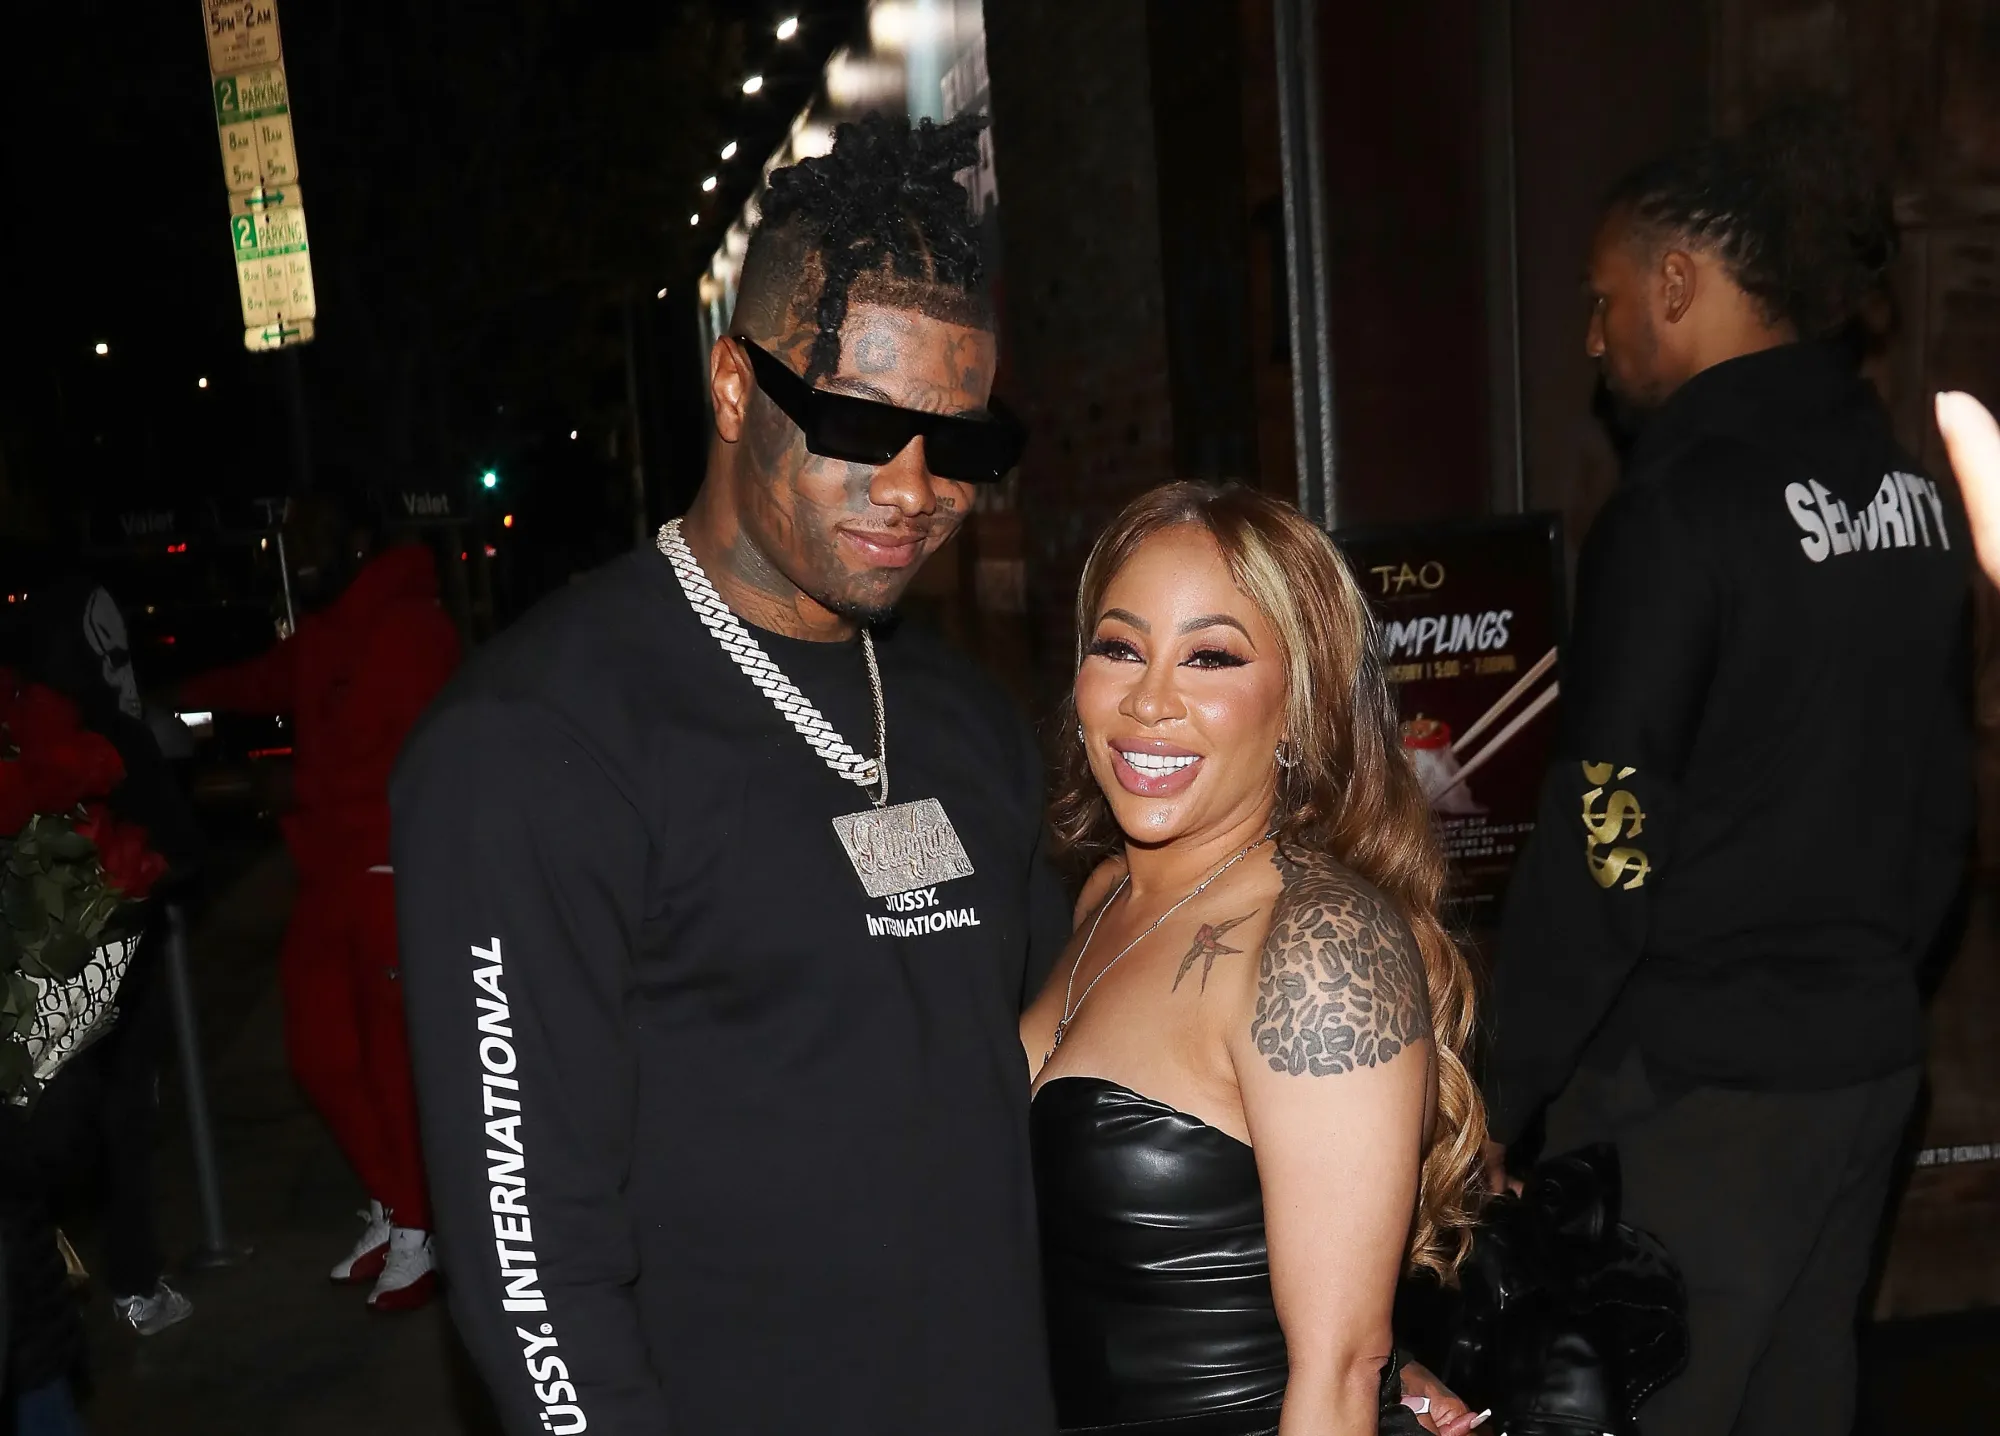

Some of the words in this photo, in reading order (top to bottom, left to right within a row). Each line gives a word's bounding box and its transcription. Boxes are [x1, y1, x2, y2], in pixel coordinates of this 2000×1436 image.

[220, 82, 233, 110] 2
[241, 80, 285, 112] PARKING
[237, 218, 253, 249] 2
[258, 222, 303, 248] PARKING
[402, 491, 450, 514] Valet
[1370, 561, 1445, 593] TAO
[865, 907, 981, 937] INTERNATIONAL
[470, 936, 548, 1312] INTERNATIONAL
